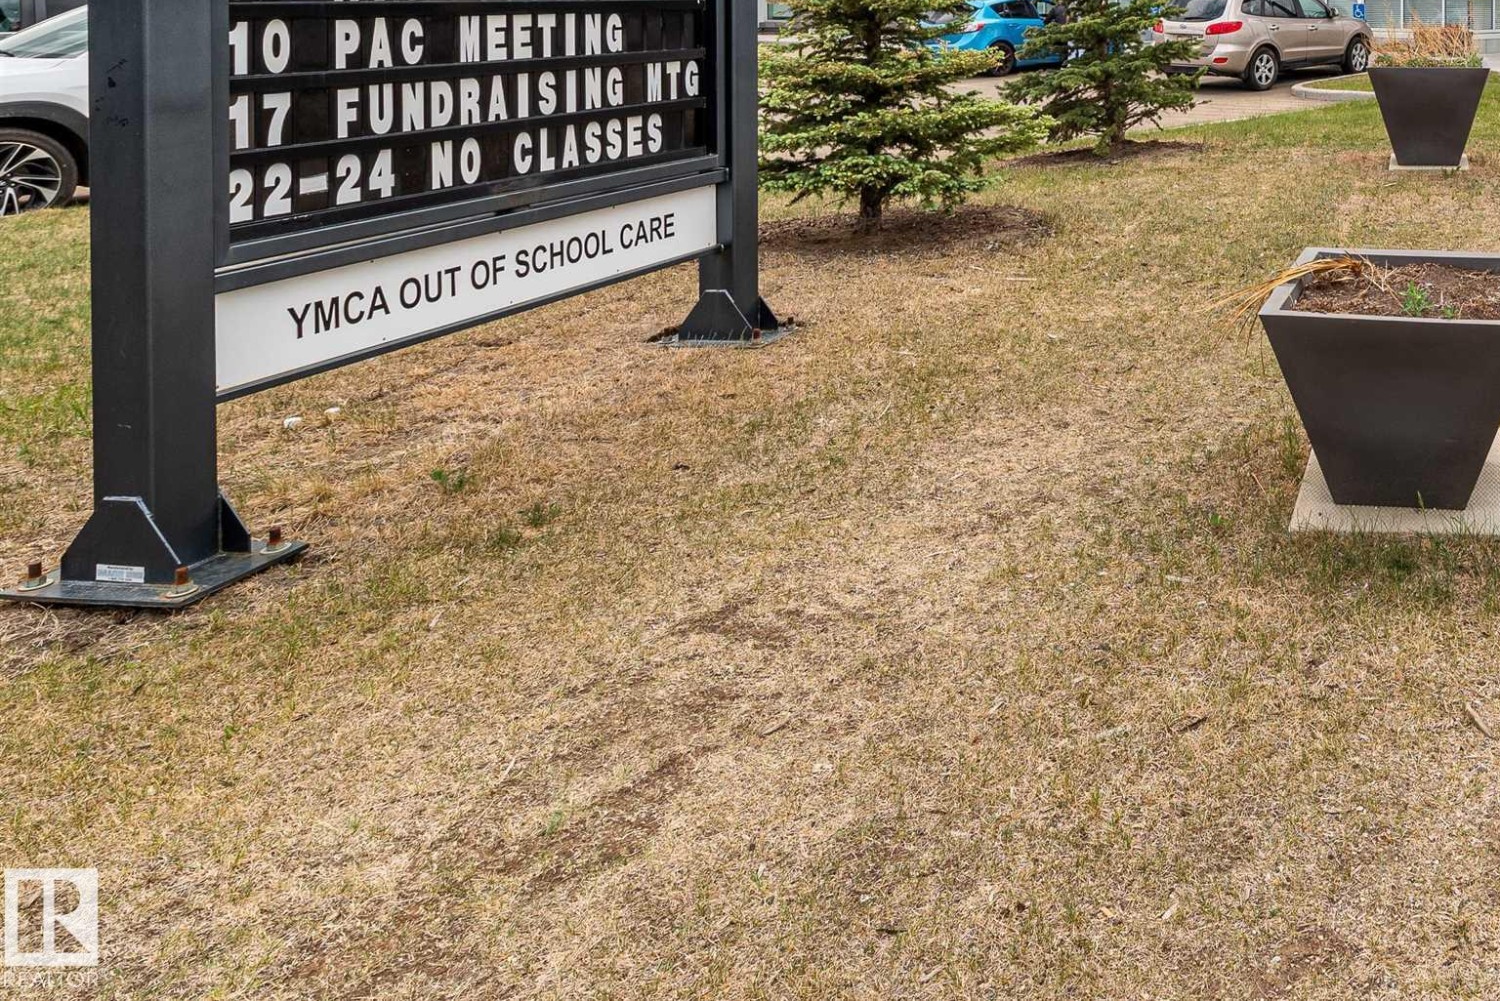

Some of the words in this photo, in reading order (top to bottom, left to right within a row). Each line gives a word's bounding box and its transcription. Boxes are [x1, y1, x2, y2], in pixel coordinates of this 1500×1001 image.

[229, 18, 291, 75] 10
[335, 17, 425, 70] PAC
[458, 12, 624, 63] MEETING
[229, 91, 292, 150] 17
[336, 66, 624, 139] FUNDRAISING
[646, 60, 699, 103] MTG
[229, 148, 396, 224] 22-24
[430, 137, 482, 190] NO
[512, 113, 663, 173] CLASSES
[286, 285, 391, 338] YMCA
[398, 266, 462, 310] OUT
[470, 254, 506, 289] OF
[514, 231, 614, 278] SCHOOL
[620, 213, 676, 248] CARE
